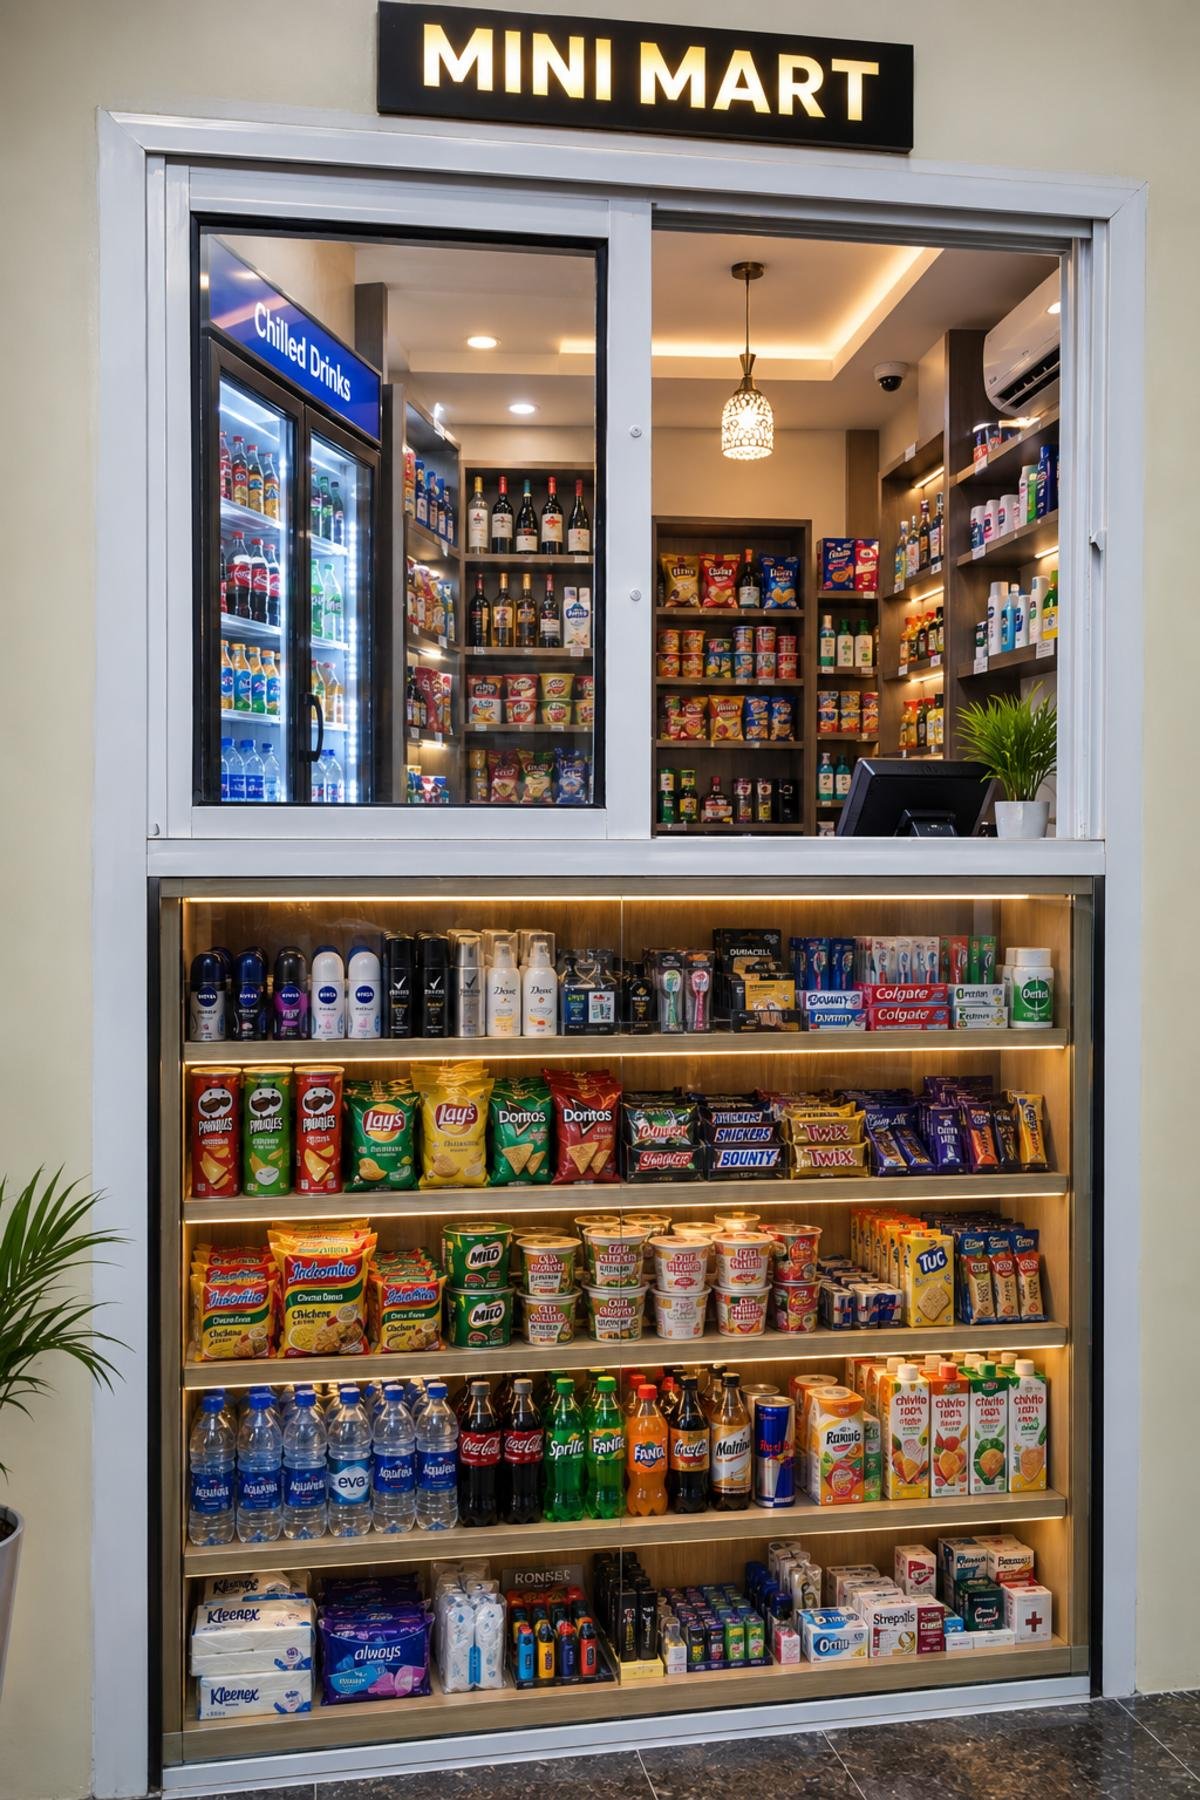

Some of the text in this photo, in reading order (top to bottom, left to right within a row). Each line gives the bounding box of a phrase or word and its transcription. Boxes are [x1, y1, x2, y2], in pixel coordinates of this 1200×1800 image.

[423, 23, 880, 122] MINI MART
[254, 302, 351, 402] Chilled Drinks
[876, 987, 928, 1003] Colgate
[470, 1248, 500, 1265] MILO
[919, 1250, 947, 1272] TUC
[338, 1476, 366, 1488] eva
[207, 1607, 261, 1624] Kleenex
[354, 1644, 401, 1663] always
[211, 1686, 260, 1705] Kleenex
